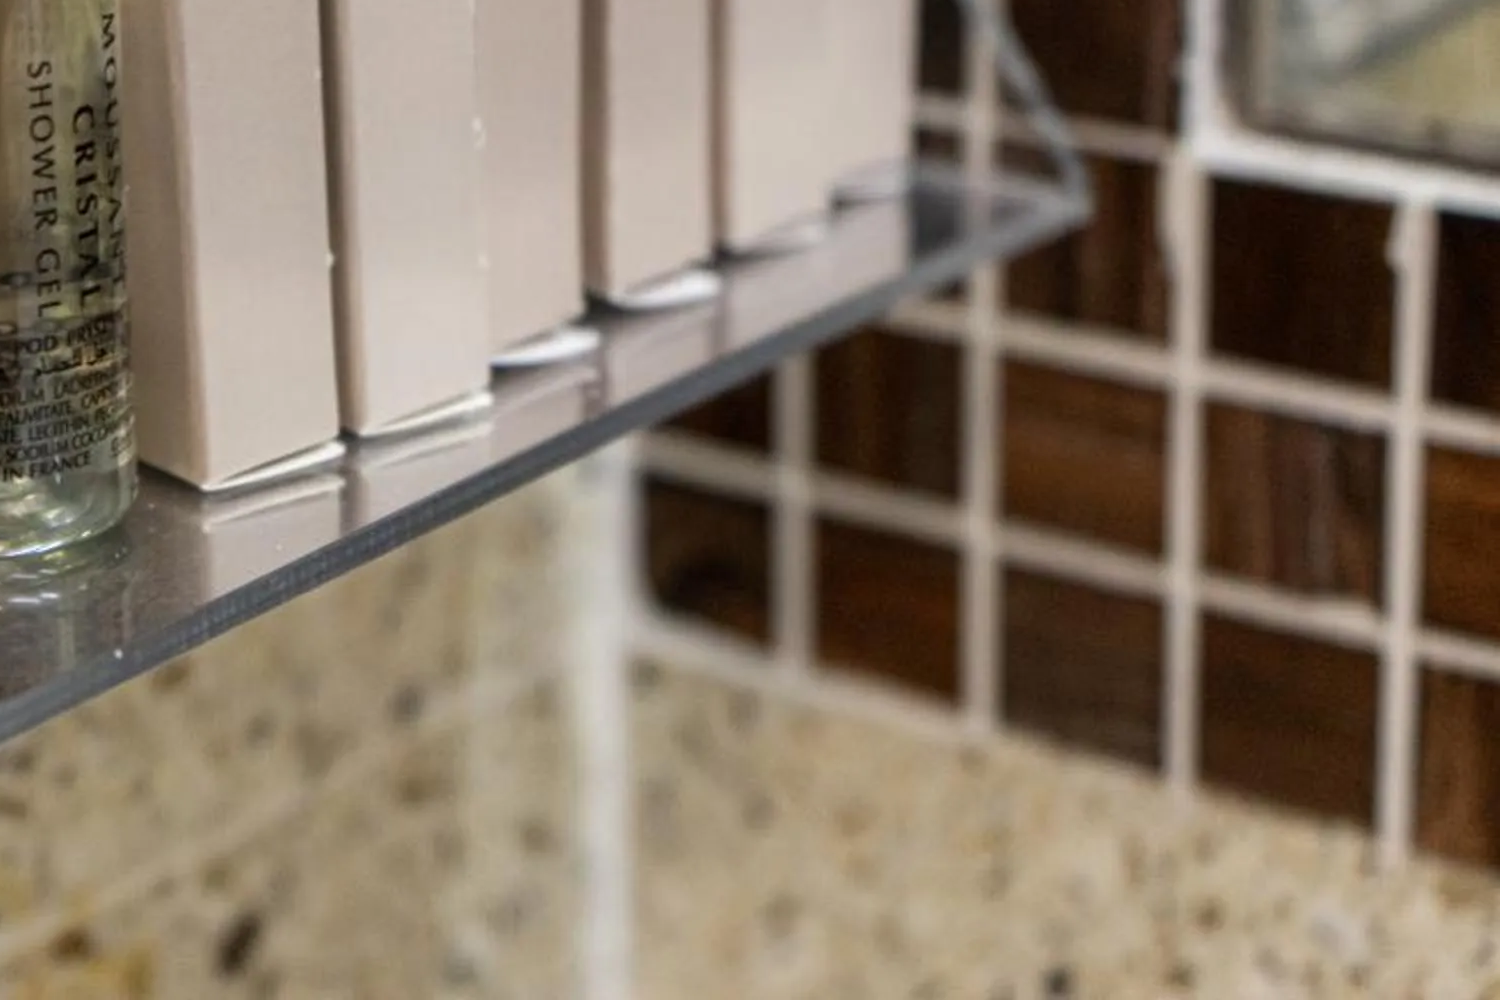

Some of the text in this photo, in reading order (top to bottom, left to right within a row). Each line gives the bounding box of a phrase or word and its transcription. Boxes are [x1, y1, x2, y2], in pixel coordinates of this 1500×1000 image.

[26, 59, 62, 319] SHOWER GEL
[71, 103, 103, 309] CRISTAL
